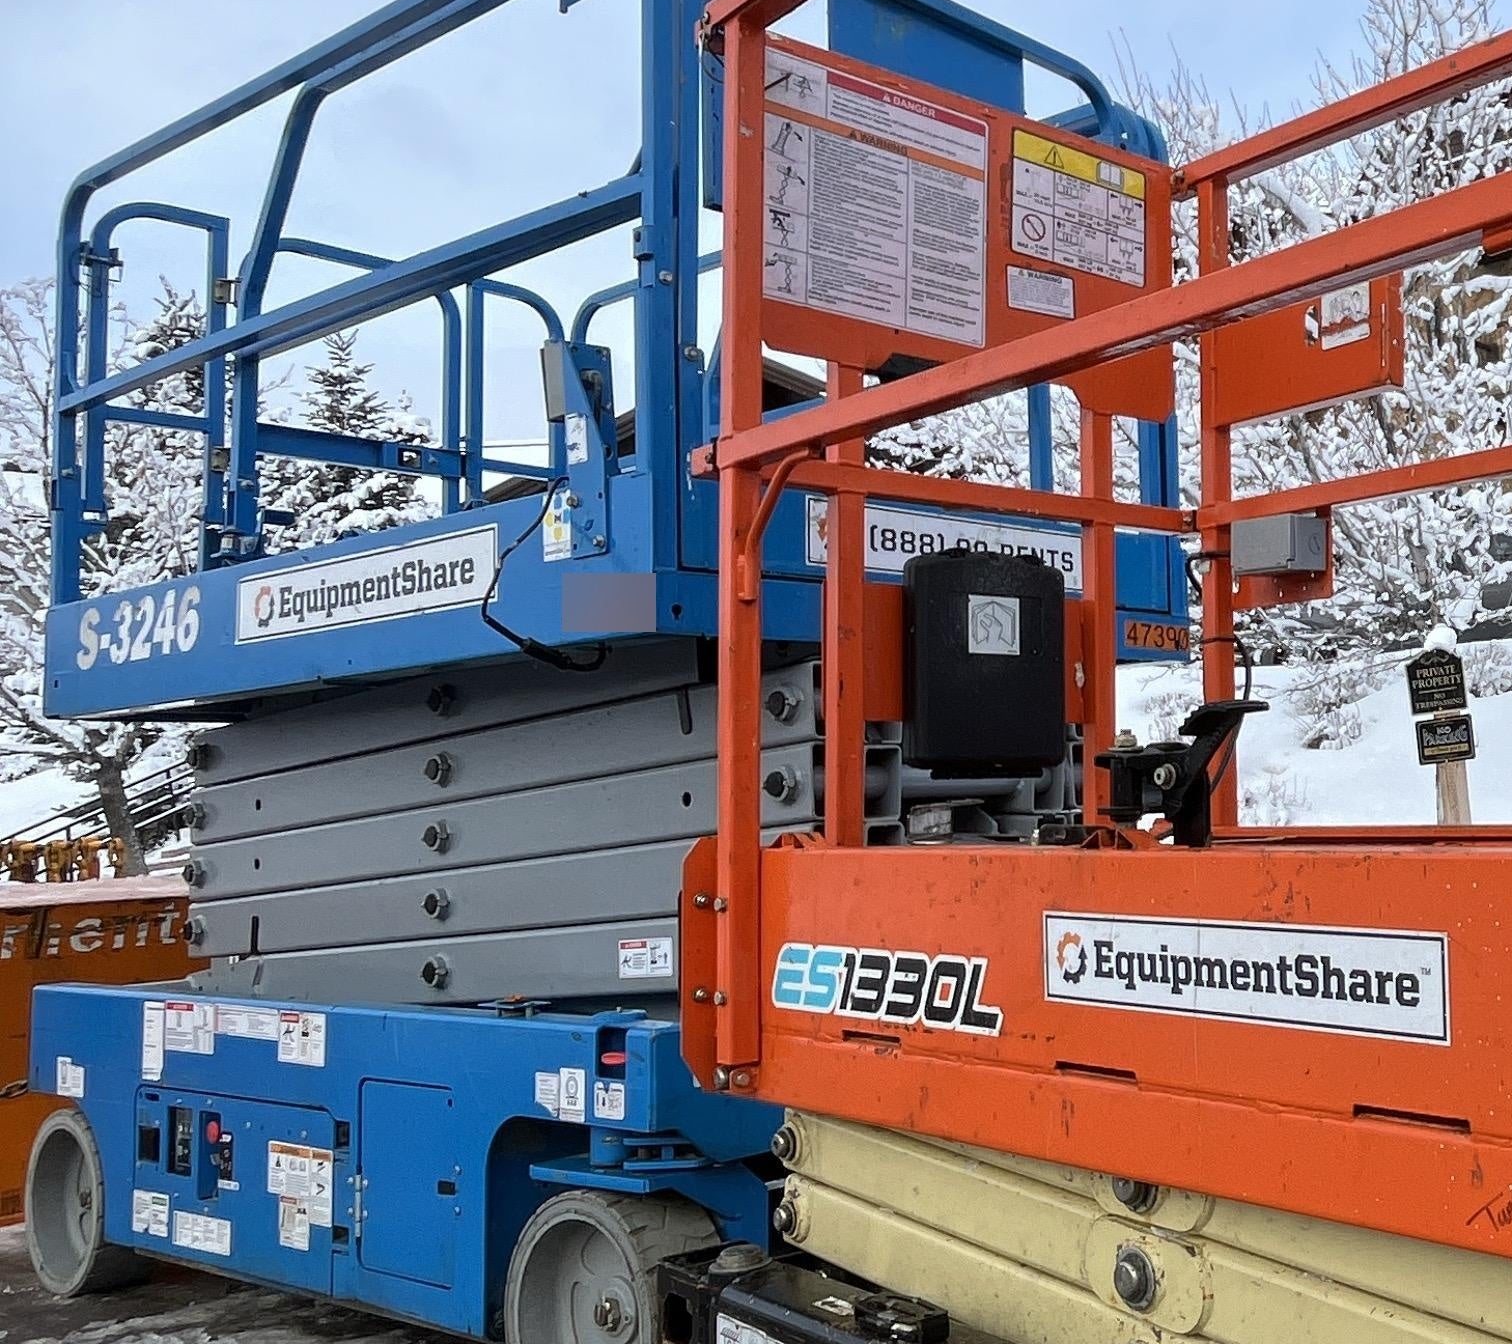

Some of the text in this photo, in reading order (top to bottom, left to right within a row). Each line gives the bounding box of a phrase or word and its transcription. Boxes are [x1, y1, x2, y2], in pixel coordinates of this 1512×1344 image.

[892, 96, 936, 119] DANGER
[869, 524, 945, 556] (888)
[278, 552, 475, 620] EquipmentShare
[76, 585, 202, 672] S-3246
[1412, 674, 1461, 689] PROPERTY
[1416, 665, 1455, 677] PRIVATE
[774, 943, 1002, 1035] ES1330L
[1092, 937, 1421, 1009] EquipmentShare
